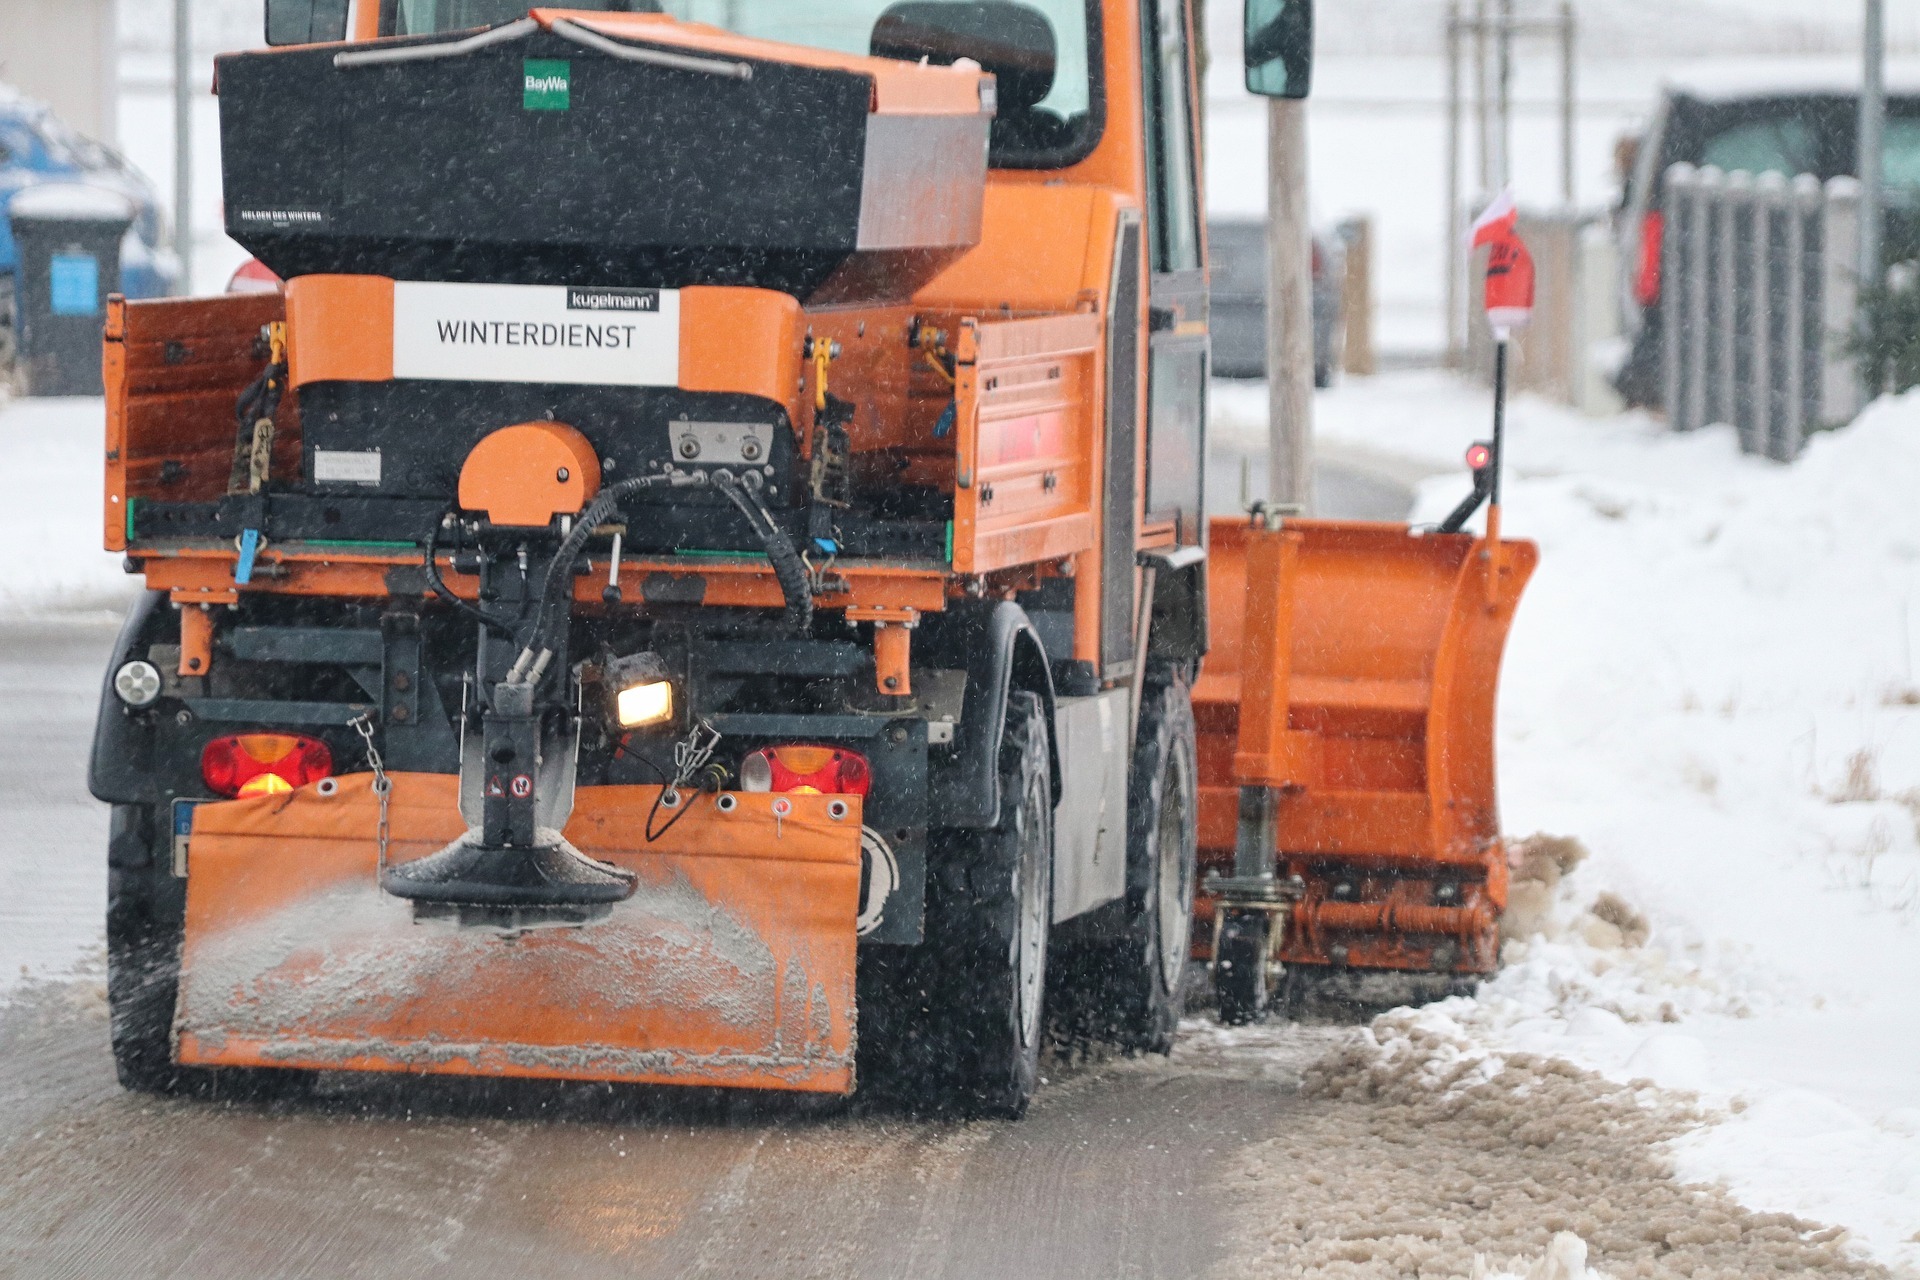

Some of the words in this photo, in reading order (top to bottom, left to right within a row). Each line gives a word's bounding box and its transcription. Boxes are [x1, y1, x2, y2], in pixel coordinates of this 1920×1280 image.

[525, 75, 567, 94] BayWa
[242, 210, 271, 220] HELDEN
[272, 211, 287, 220] DES
[288, 211, 321, 221] WINTERS
[436, 320, 636, 349] WINTERDIENST
